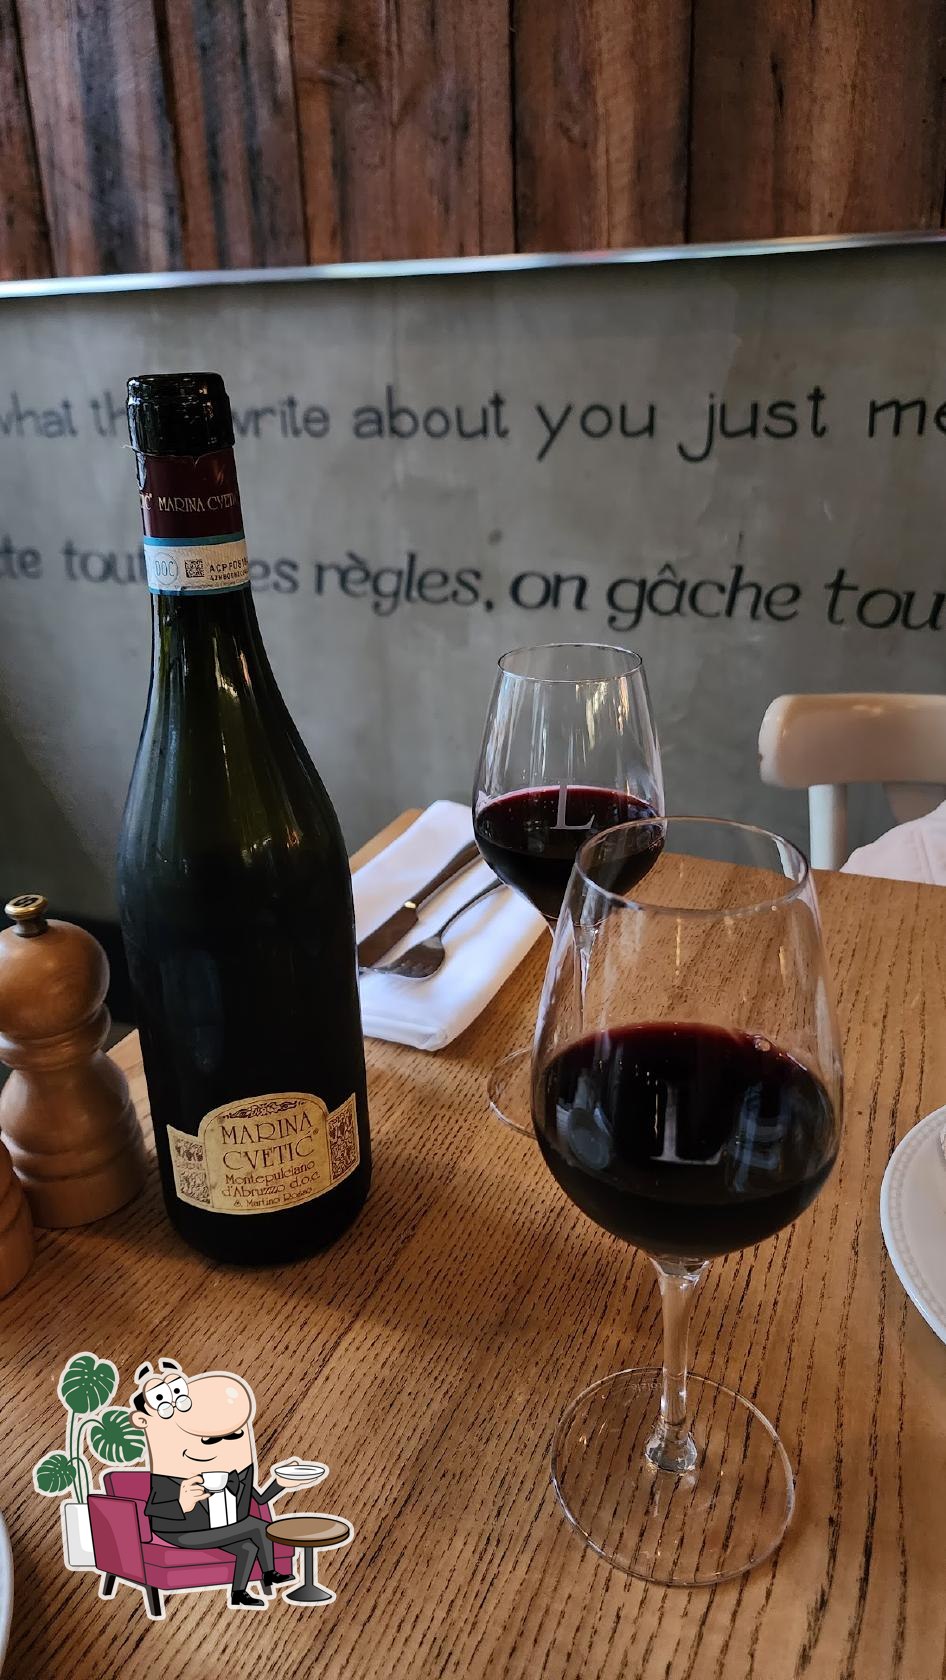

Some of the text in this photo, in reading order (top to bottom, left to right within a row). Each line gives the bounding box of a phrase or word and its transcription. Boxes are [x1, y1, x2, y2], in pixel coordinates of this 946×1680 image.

[353, 384, 509, 439] about
[536, 404, 656, 461] you
[678, 386, 827, 462] just
[158, 495, 206, 512] MARINA
[510, 571, 588, 610] on
[606, 564, 801, 632] gâche
[549, 779, 595, 830] L
[221, 1111, 313, 1145] MARINA
[649, 1080, 726, 1165] L
[225, 1160, 315, 1186] Montepulciano
